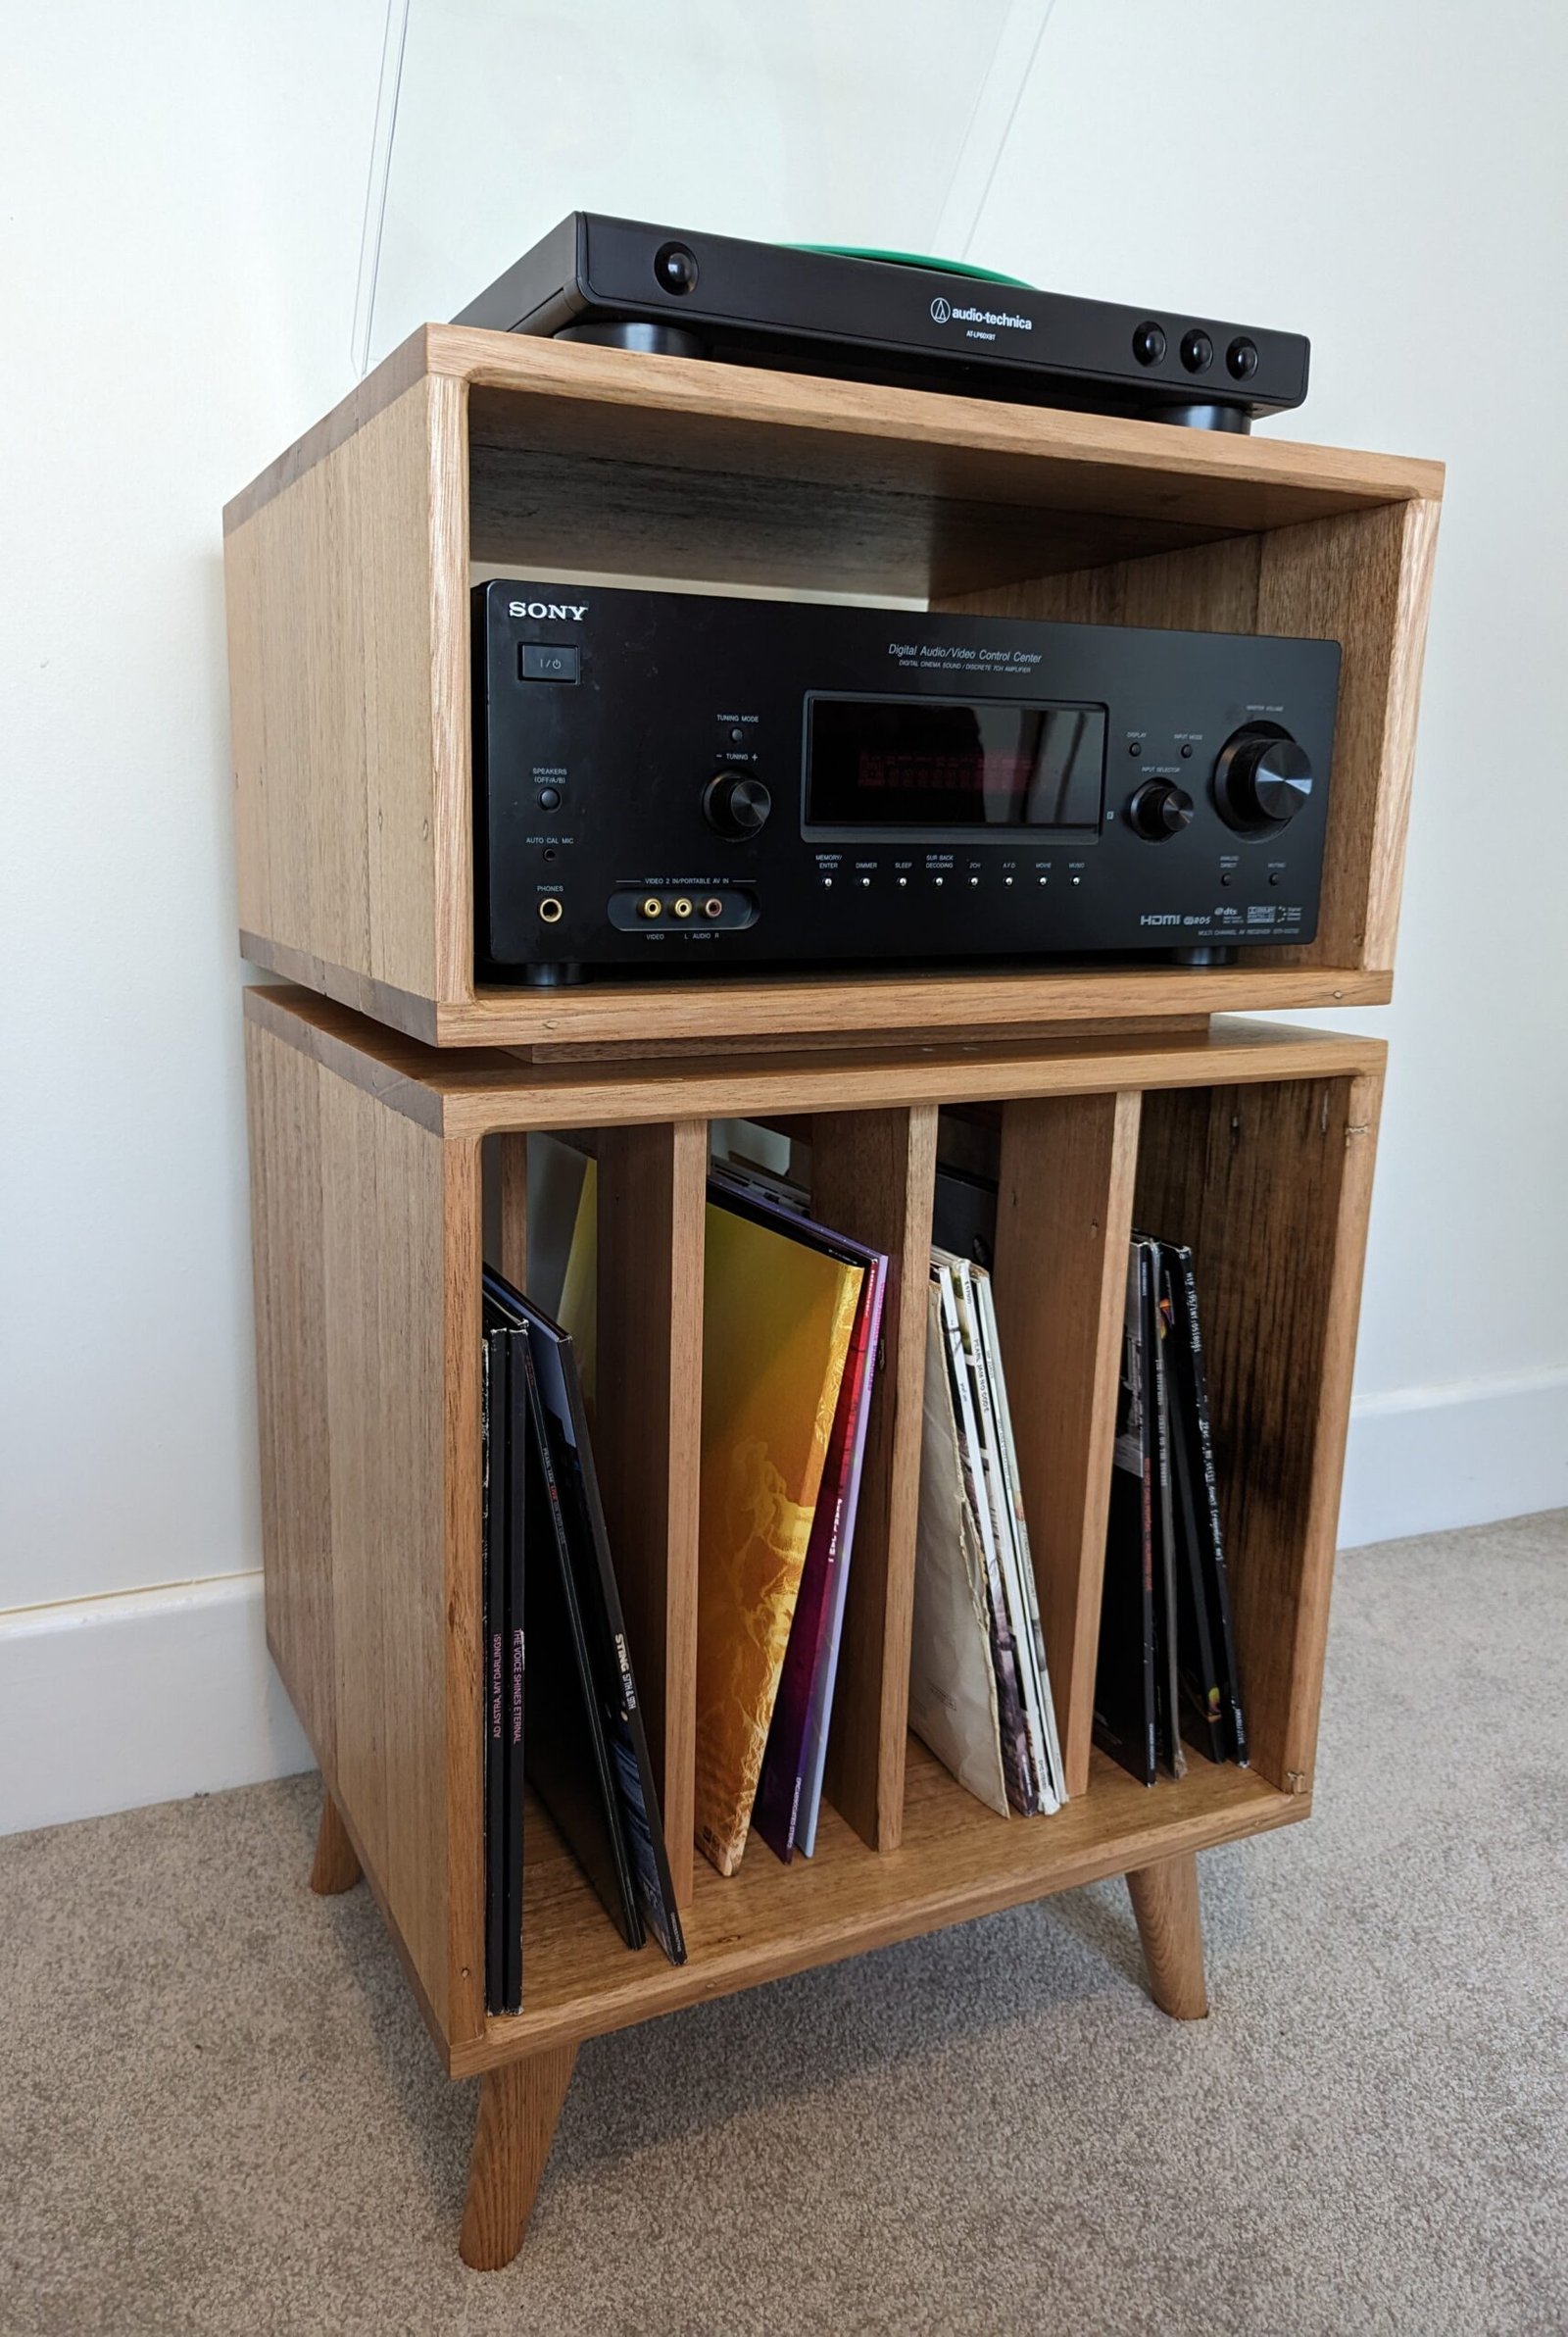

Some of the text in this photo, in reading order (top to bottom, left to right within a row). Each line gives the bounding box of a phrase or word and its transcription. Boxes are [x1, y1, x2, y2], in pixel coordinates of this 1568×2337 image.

[952, 308, 1032, 329] audio-technica
[509, 602, 588, 622] SONY
[888, 643, 1043, 664] Digital Audio/Video Control Center
[1140, 915, 1181, 926] HDMI
[614, 1633, 629, 1672] STING
[493, 1632, 503, 1738] AD ASTRA, MY DARLINGS!
[513, 1628, 521, 1744] THE VOICE SHINES ETERNAL
